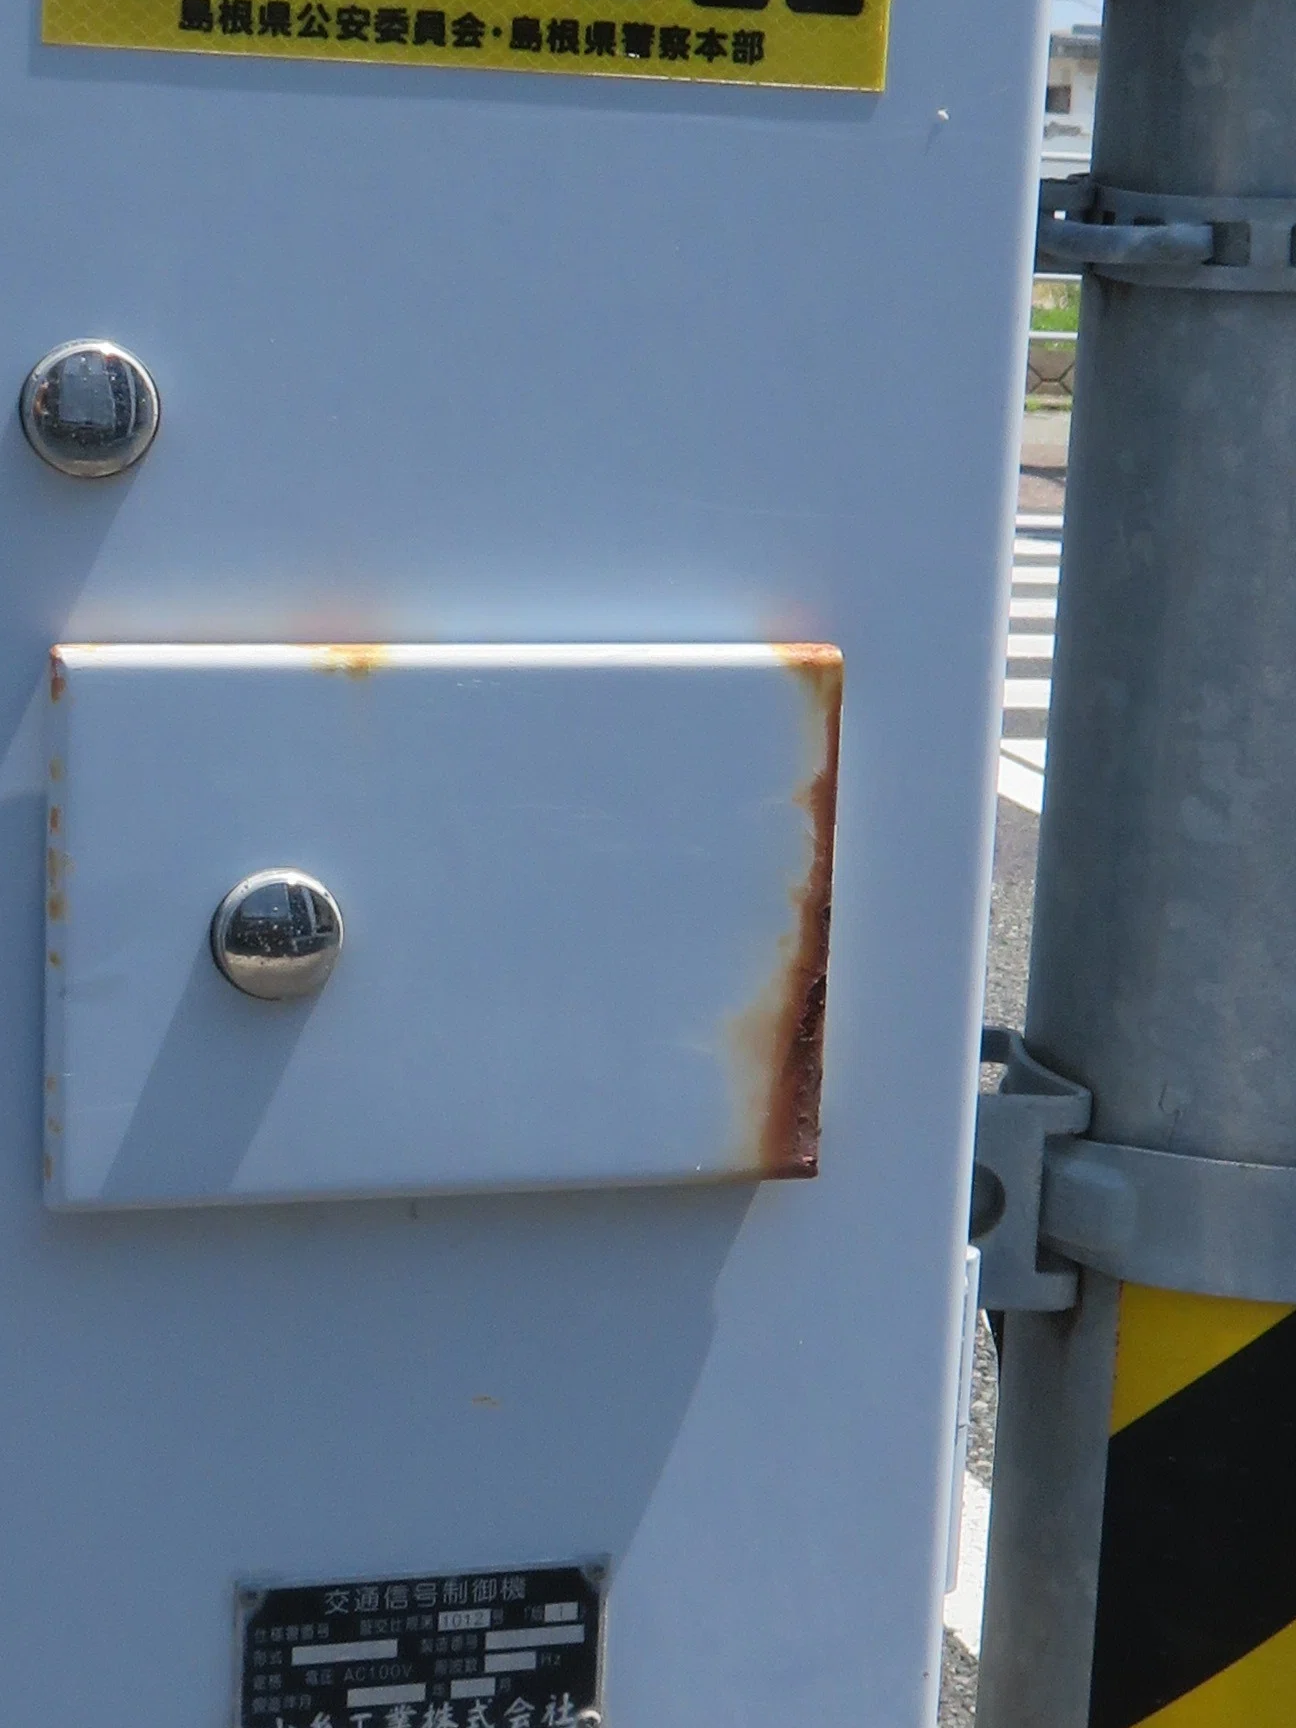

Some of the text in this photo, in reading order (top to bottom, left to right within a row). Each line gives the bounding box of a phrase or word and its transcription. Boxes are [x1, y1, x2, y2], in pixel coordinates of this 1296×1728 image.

[324, 1576, 526, 1615] 交通信号制御機
[442, 1611, 485, 1629] 1012
